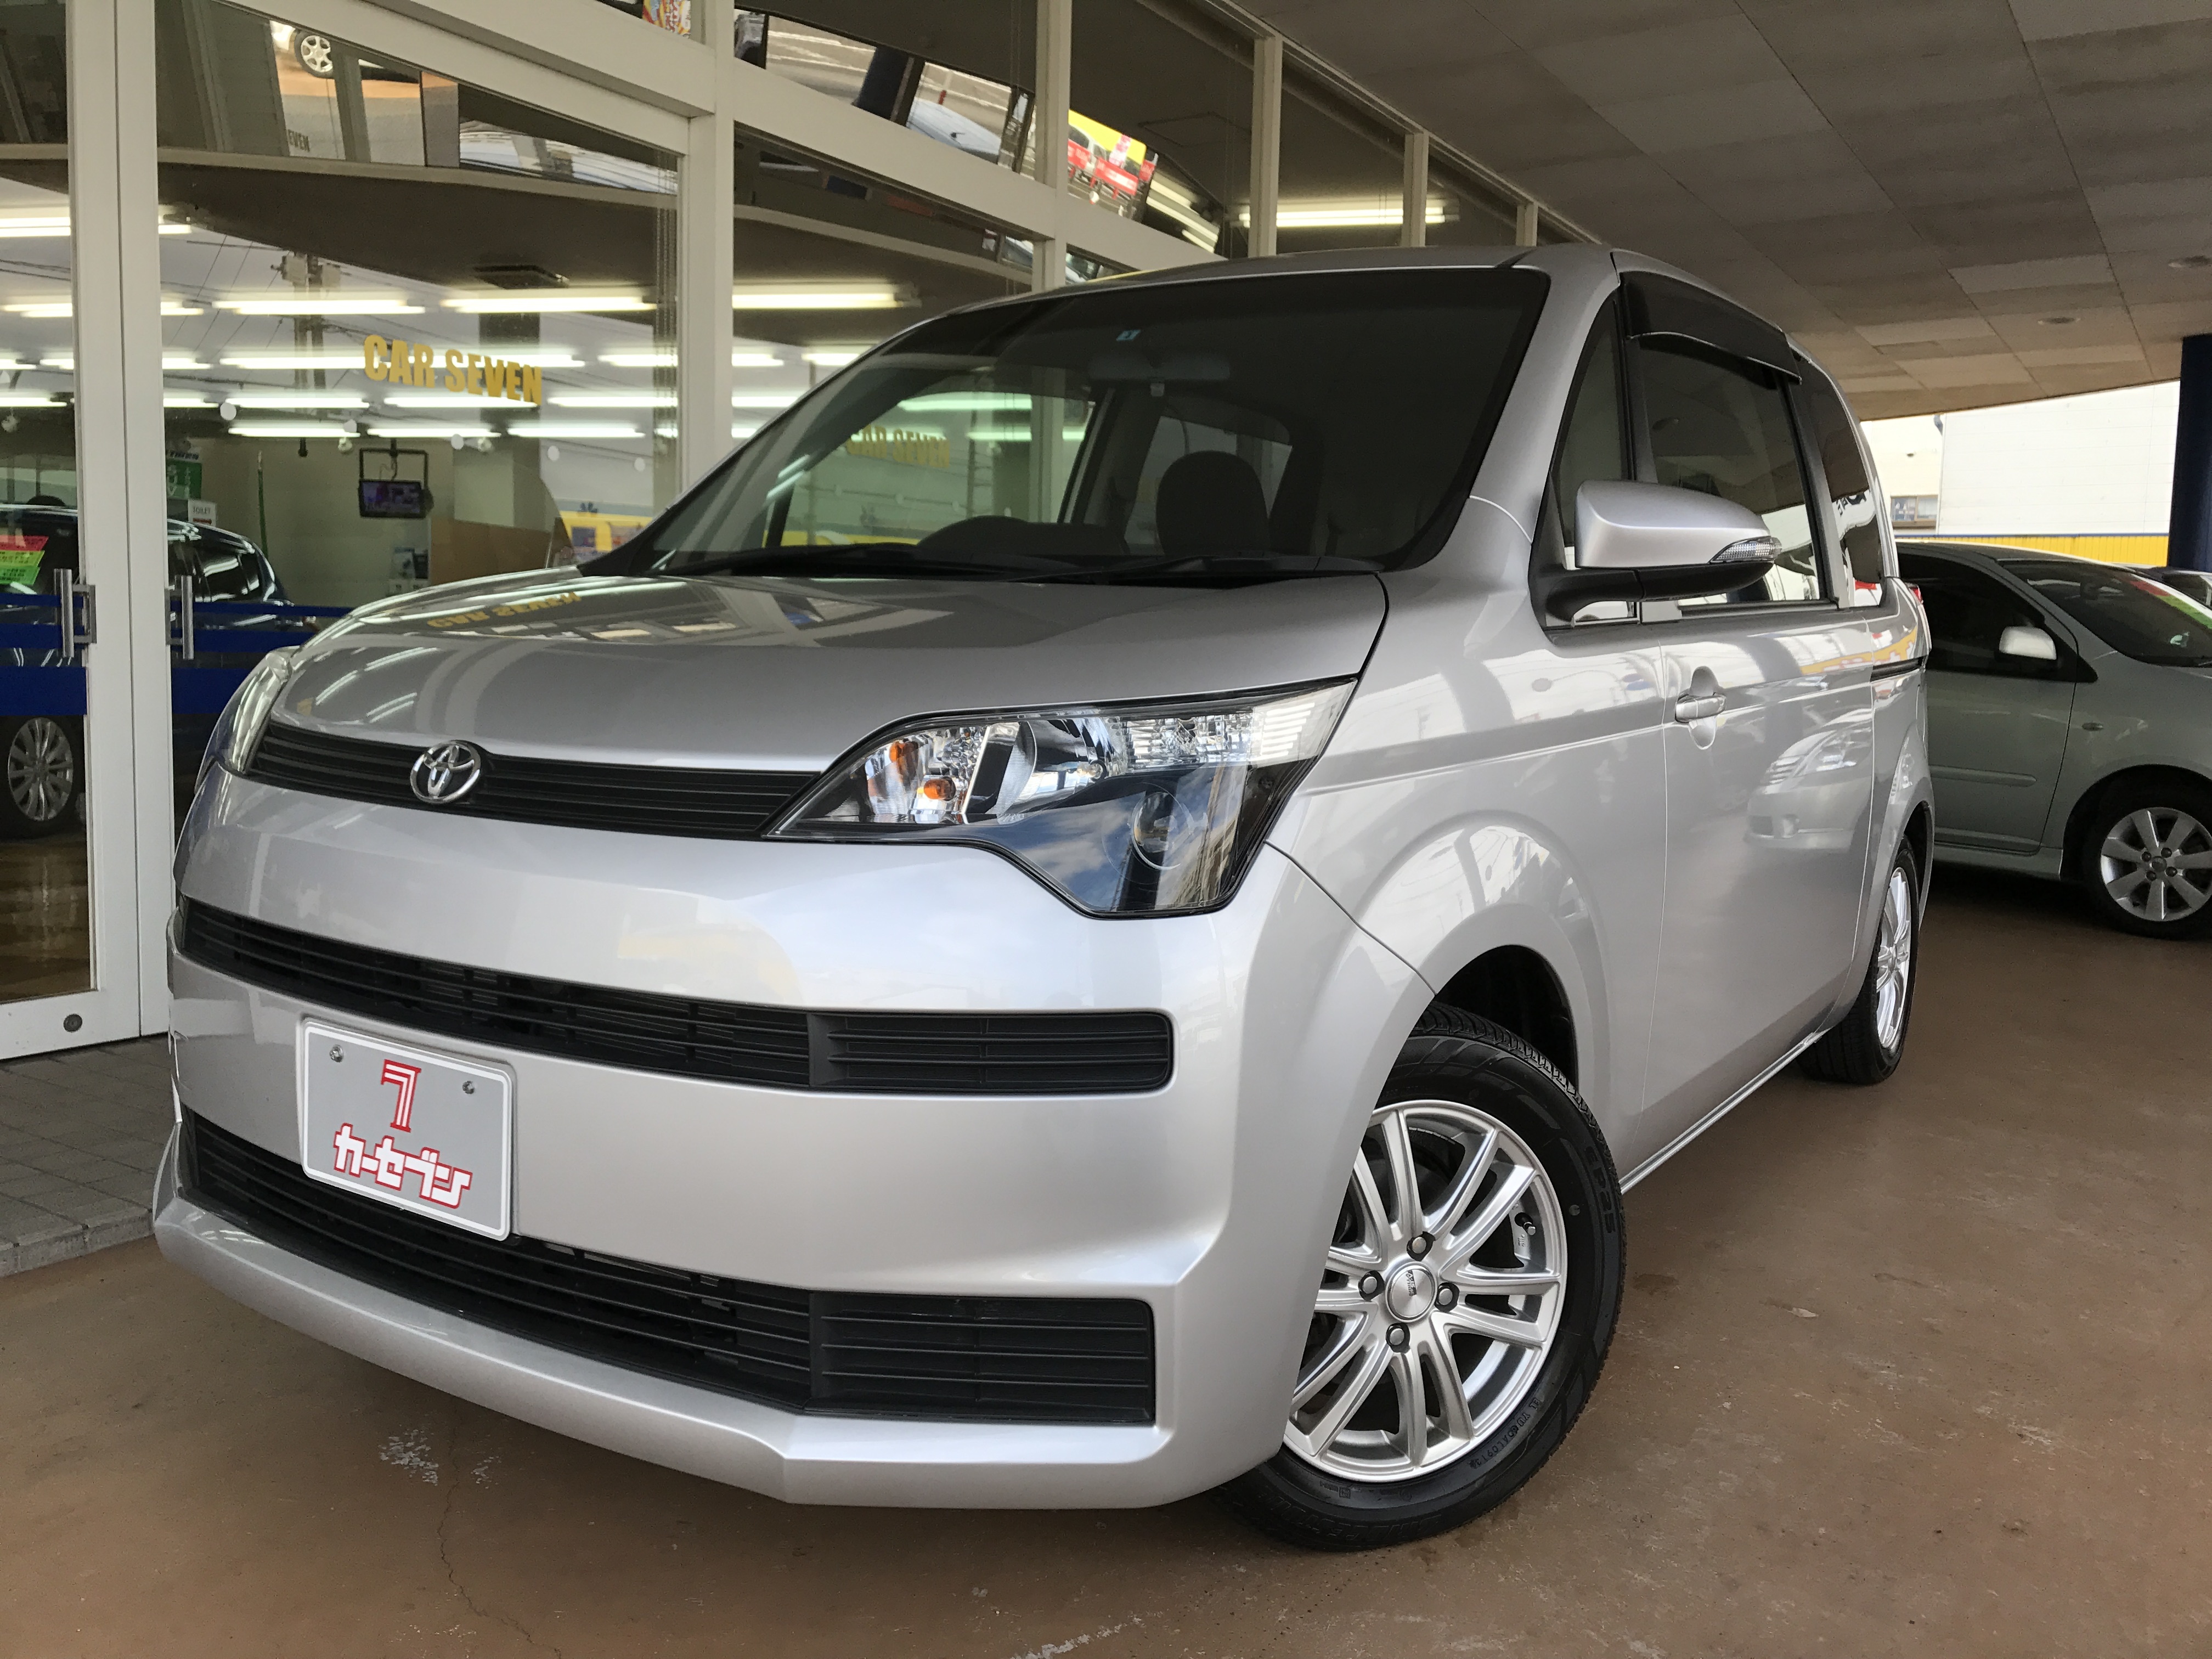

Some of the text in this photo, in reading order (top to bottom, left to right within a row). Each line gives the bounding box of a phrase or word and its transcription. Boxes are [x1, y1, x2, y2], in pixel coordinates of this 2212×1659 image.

[364, 334, 542, 405] CAR SEVEN
[333, 1122, 473, 1209] カーセブン
